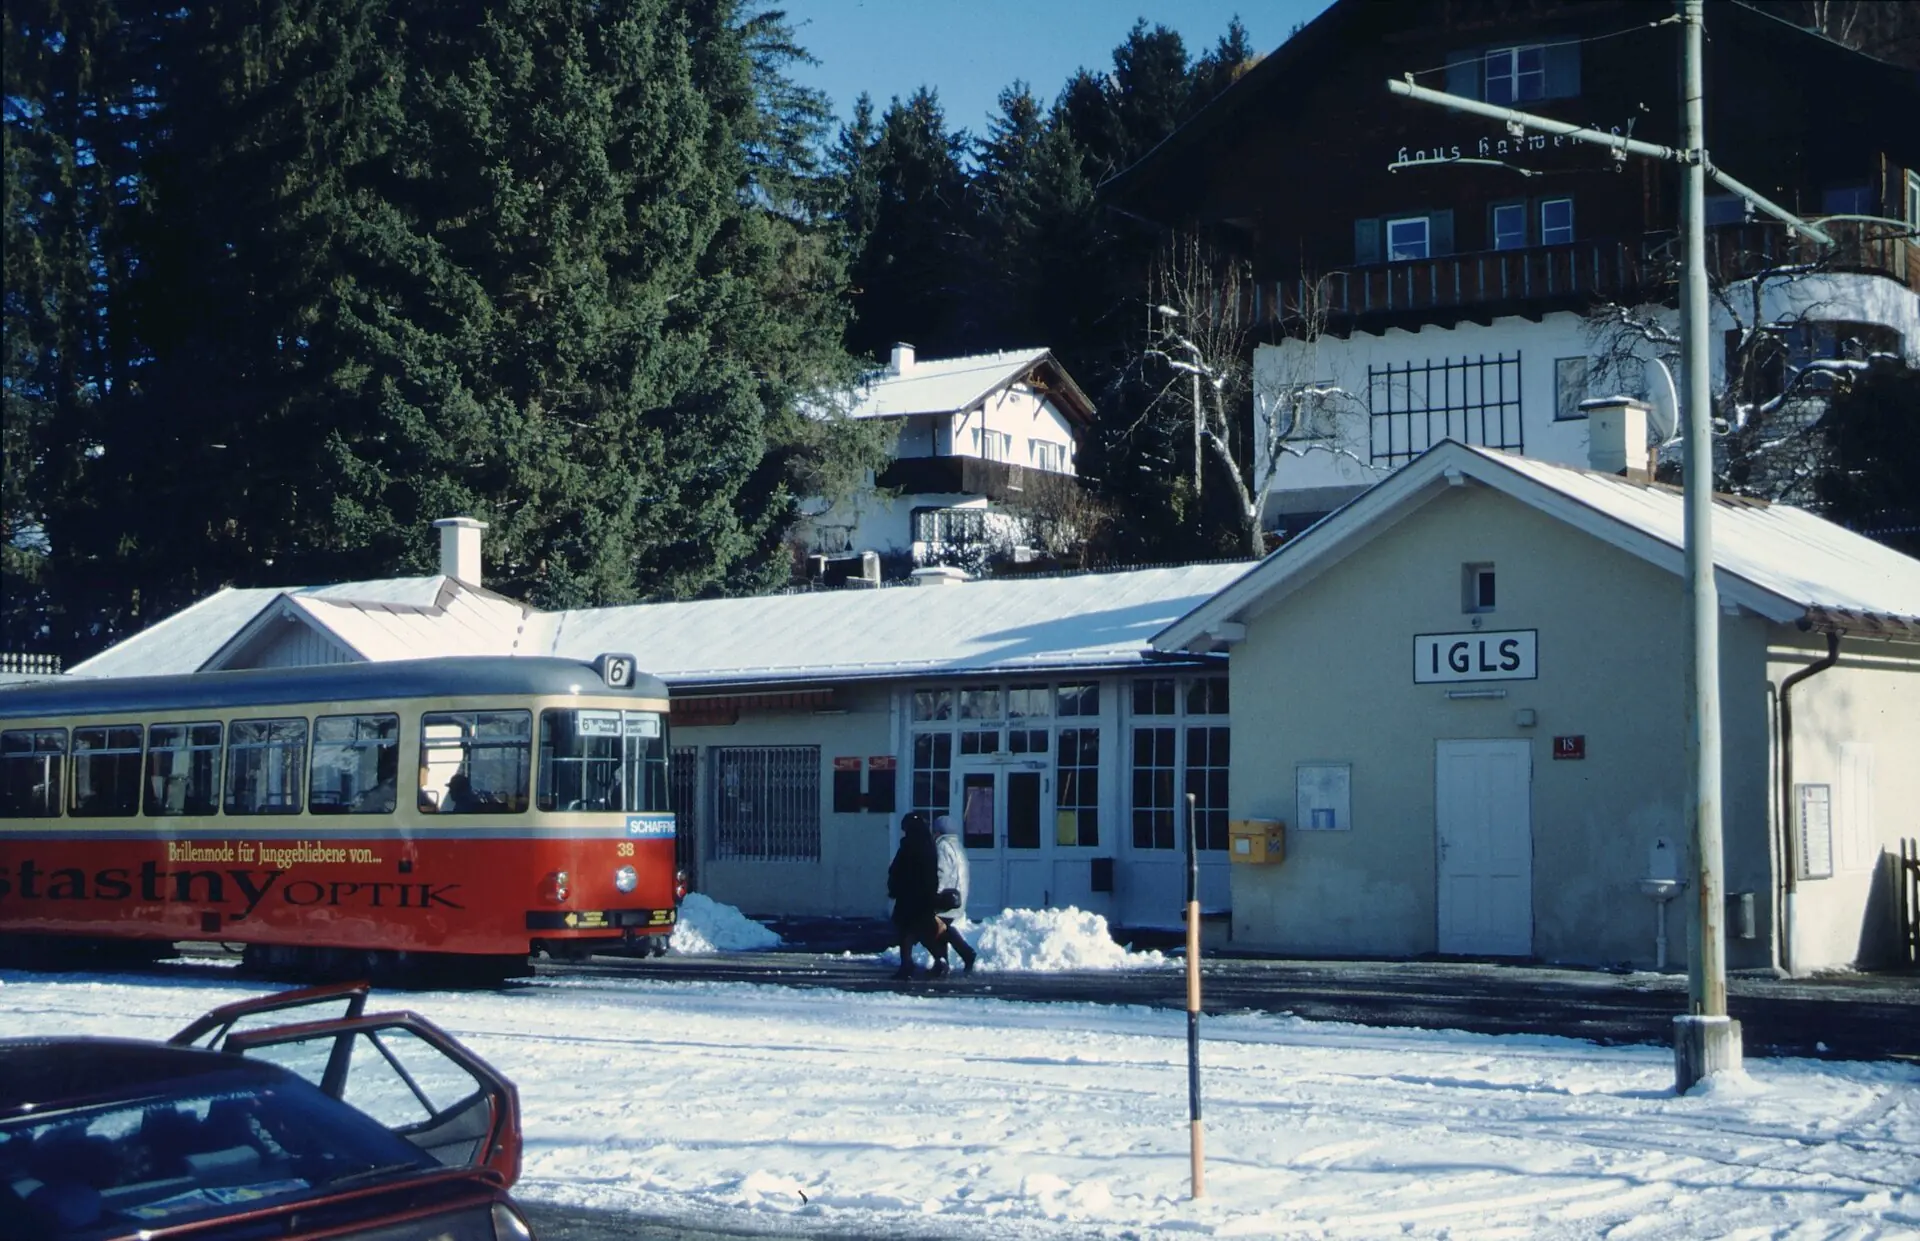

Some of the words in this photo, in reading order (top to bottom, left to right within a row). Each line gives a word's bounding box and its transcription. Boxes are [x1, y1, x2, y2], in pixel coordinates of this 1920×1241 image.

[1431, 639, 1521, 674] IGLS
[610, 659, 625, 682] 6
[582, 718, 590, 731] 6
[1562, 737, 1575, 751] 18
[168, 841, 234, 862] Brillenmode
[238, 841, 255, 862] für
[258, 842, 346, 869] Junggebliebene
[349, 848, 382, 864] von...
[617, 842, 635, 857] 38
[283, 880, 466, 910] OPTIK
